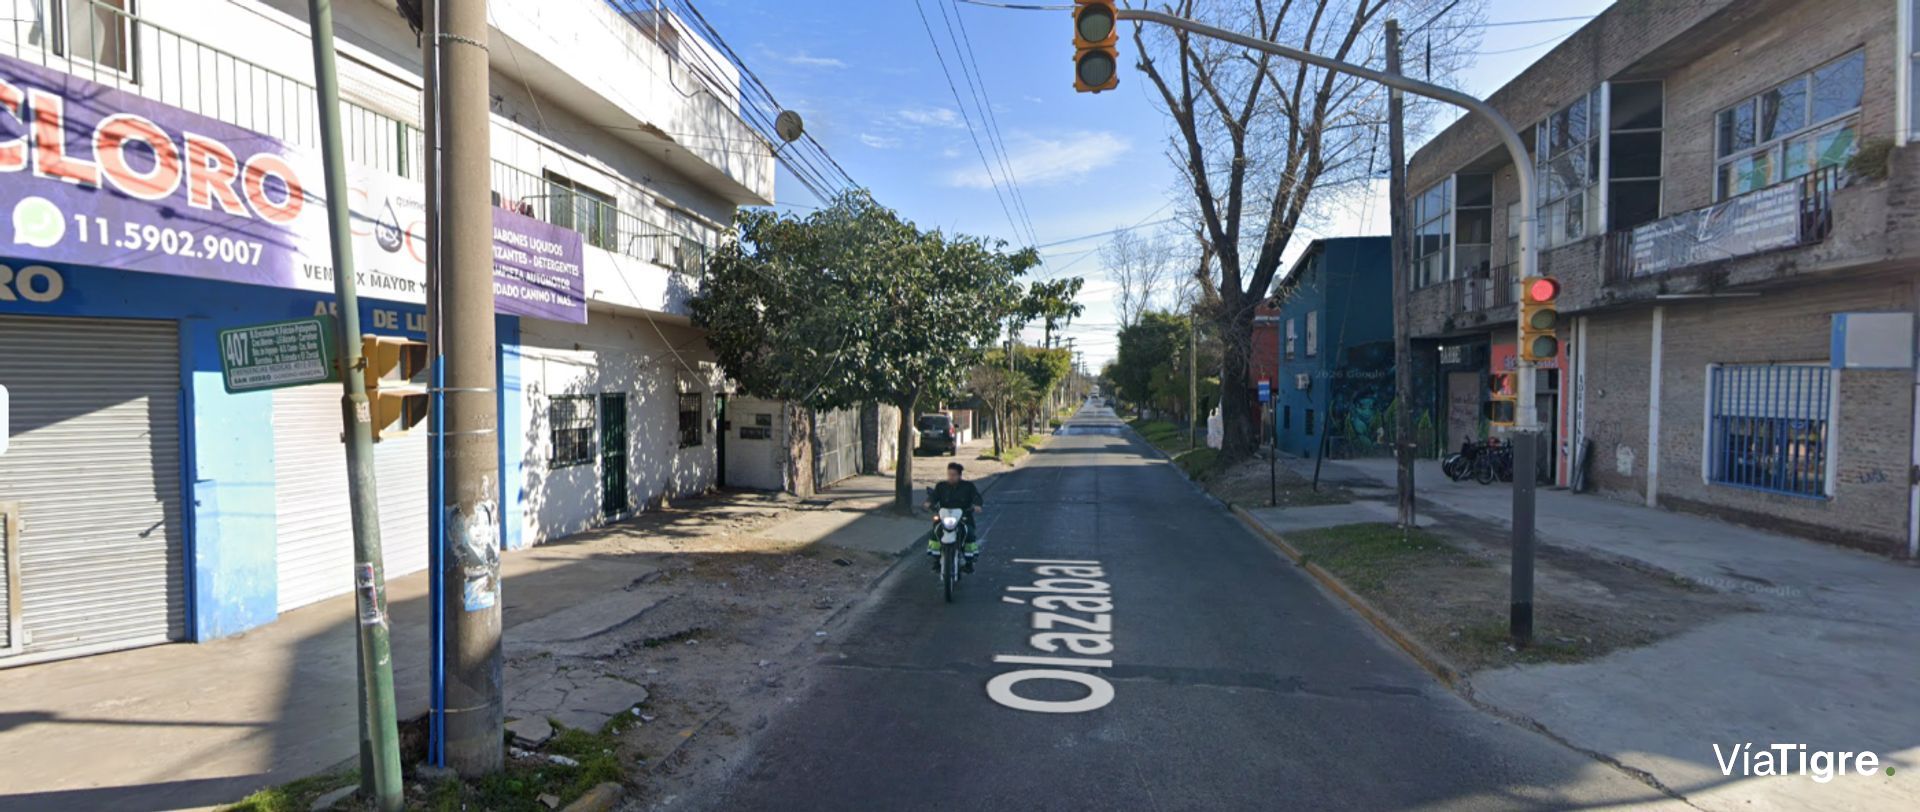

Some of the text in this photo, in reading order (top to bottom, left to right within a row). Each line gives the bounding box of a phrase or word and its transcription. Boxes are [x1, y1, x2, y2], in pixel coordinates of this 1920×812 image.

[74, 213, 264, 266] 11.5902.9007
[493, 227, 528, 248] JABONES
[533, 255, 579, 277] DETERGENTES
[303, 264, 334, 282] VEN
[356, 271, 366, 287] X
[370, 274, 416, 294] MAYOR
[520, 286, 550, 303] CANINO
[373, 309, 399, 330] DE
[227, 331, 249, 367] 407
[249, 374, 271, 382] ISIDRO
